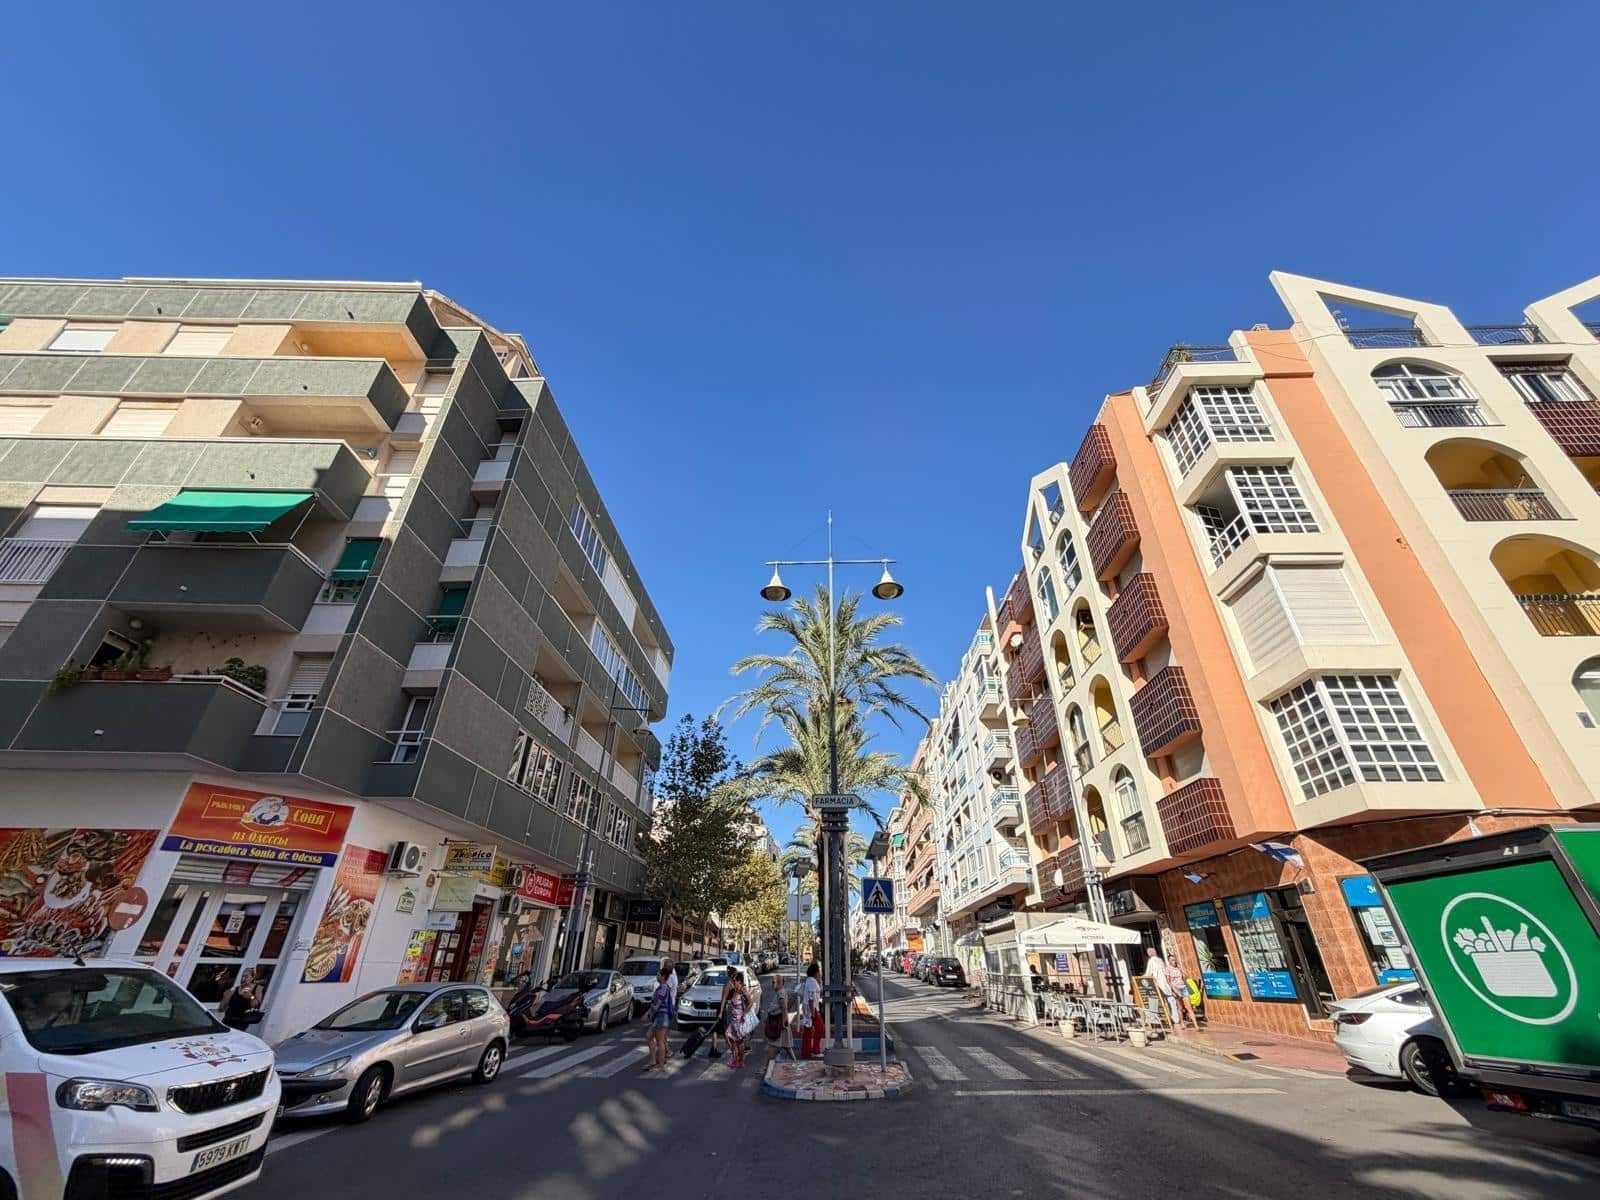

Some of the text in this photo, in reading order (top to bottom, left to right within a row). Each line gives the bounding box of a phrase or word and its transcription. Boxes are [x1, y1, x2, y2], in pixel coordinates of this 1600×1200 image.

[815, 797, 855, 805] FARMACIA
[180, 840, 323, 865] La pescadora Sonia de Odessa
[199, 1147, 226, 1168] 5979
